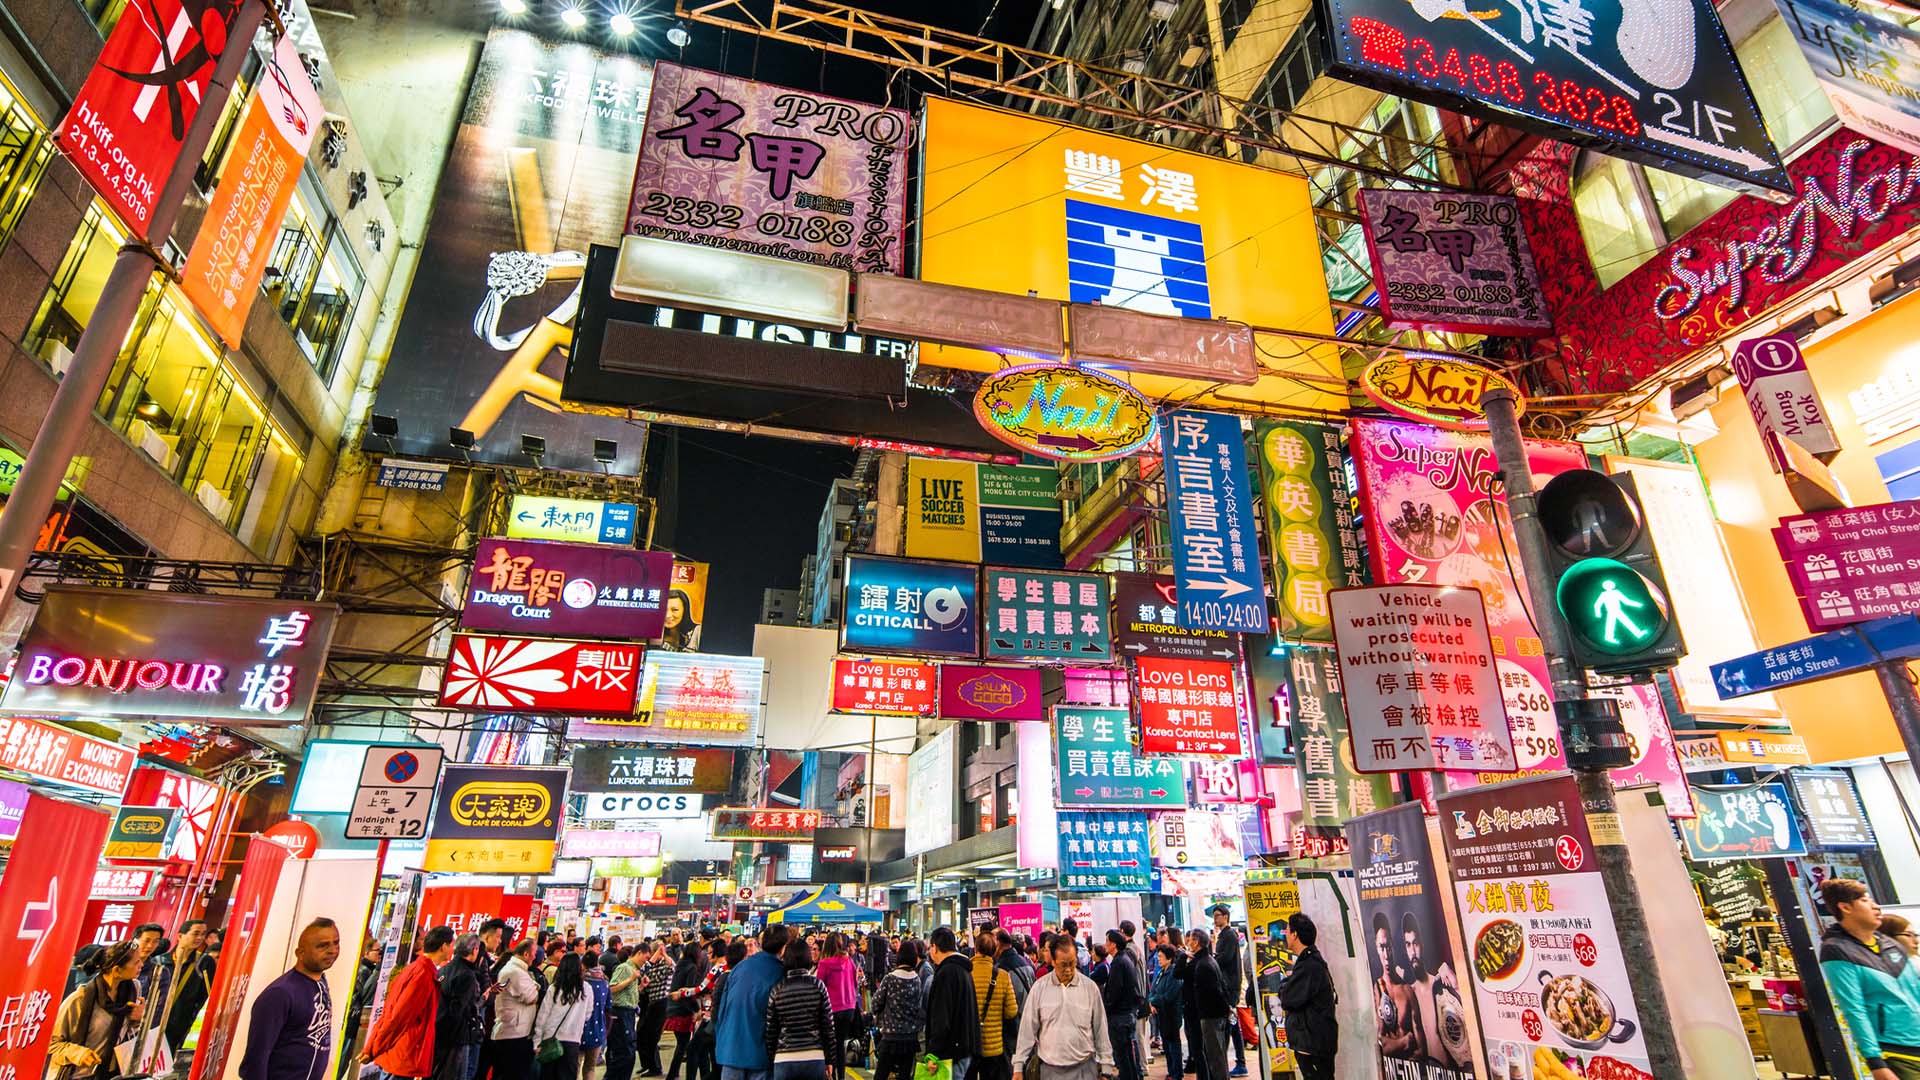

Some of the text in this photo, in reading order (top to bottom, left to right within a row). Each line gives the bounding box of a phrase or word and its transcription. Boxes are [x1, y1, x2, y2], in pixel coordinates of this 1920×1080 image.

[1411, 38, 1639, 136] 3488 3628
[773, 94, 904, 145] PRO
[1654, 93, 1736, 143] 2/F
[77, 100, 155, 203] hkiff.org.hk
[656, 87, 826, 200] 名甲
[69, 124, 147, 221] 21.3-4.4.2016
[1064, 149, 1199, 213] 豐澤
[209, 138, 277, 298] HONG KONG
[217, 180, 248, 240] WORLD
[641, 193, 854, 246] 2332 0188
[1434, 201, 1517, 227] PRO
[635, 223, 854, 269] www.supernail.com.hk
[1377, 205, 1476, 274] 名甲
[203, 242, 222, 283] CITY
[1388, 282, 1512, 305] 2332 0188
[991, 376, 1130, 437] Nail
[1775, 390, 1803, 436] Mong
[1797, 394, 1823, 426] Kok
[1375, 426, 1454, 472] Super
[920, 478, 964, 500] LIVE
[1172, 414, 1228, 574] 序言書室
[921, 499, 965, 514] SOCCER
[1217, 443, 1246, 572] 專營人文及社會書籍
[541, 506, 594, 529] 東大門
[921, 513, 965, 525] MATCHES
[1272, 436, 1327, 617] 華英書局
[1825, 510, 1878, 528] 通菜街
[605, 527, 627, 538] 5樓
[1832, 526, 1888, 541] Tung Choi
[1840, 546, 1893, 563] 花園街
[479, 547, 566, 606] 龍閣
[1845, 562, 1904, 576] Fa Yuen
[599, 586, 661, 602] 火鍋料理
[860, 584, 922, 614] 鐳射
[997, 577, 1099, 606] 學生書屋
[1379, 592, 1442, 608] Vehicle
[473, 590, 552, 620] Dragon Court
[630, 600, 660, 609] CUISINE
[1184, 601, 1262, 629] 14:00-24:00
[1860, 602, 1899, 615] Mong
[855, 613, 933, 631] CITICALL
[998, 608, 1100, 636] 買賣課本
[1131, 622, 1188, 635] METROPOLIS
[1351, 611, 1472, 628] waiting will be
[1368, 630, 1464, 647] prosecuted
[239, 611, 311, 714] 卓悅
[576, 650, 632, 671] 美心
[1347, 649, 1488, 667] without warning
[1763, 646, 1815, 669] 亞皆老街
[26, 655, 224, 693] BONJOUR
[851, 662, 919, 677] Love Lens
[1141, 667, 1227, 688] Love Lens
[1769, 656, 1840, 682] Argyle Street
[572, 670, 630, 692] MX
[844, 676, 927, 691] 韓國隱形眼鏡
[974, 681, 1011, 693] SALON
[1376, 671, 1475, 696] 停車等候
[855, 702, 873, 710] Korea
[875, 703, 899, 711] Contact
[918, 704, 930, 712] 3/F
[865, 691, 904, 704] 專門店
[973, 692, 1012, 704] GOGO
[1141, 686, 1234, 708] 韓國隱形眼鏡
[1518, 693, 1550, 712] $68
[1167, 708, 1213, 727] 專門店
[1381, 704, 1481, 728] 會被檢控
[1145, 726, 1236, 740] Korea Contact Lens
[1292, 657, 1340, 819] 中學舊書
[80, 741, 123, 767] MONEY
[1195, 741, 1208, 751] 3/F
[1526, 737, 1559, 757] $98
[1765, 743, 1807, 754] FORTRESS
[611, 756, 697, 777] 六福珠寶
[1068, 750, 1175, 778] 買賣舊課本
[63, 762, 125, 792] EXCHANGE
[608, 777, 694, 785] LUKFOOK JEWELLERY
[367, 797, 391, 808] 上午
[405, 792, 418, 808] 7
[601, 794, 687, 811] crocs
[354, 816, 395, 825] midnight
[361, 825, 385, 836] 午夜
[399, 819, 421, 836] 12
[1558, 840, 1580, 867] 3/F
[1750, 837, 1774, 852] 2/F
[464, 850, 533, 863] 本商場一樓
[1523, 863, 1539, 872] 2397
[1541, 862, 1556, 870] 3811
[1119, 874, 1134, 884] $10
[1386, 863, 1403, 874] THE
[1362, 872, 1418, 888] ANNIVERSARY
[1465, 879, 1554, 914] 火鍋宵夜
[1004, 916, 1039, 927] Emarket
